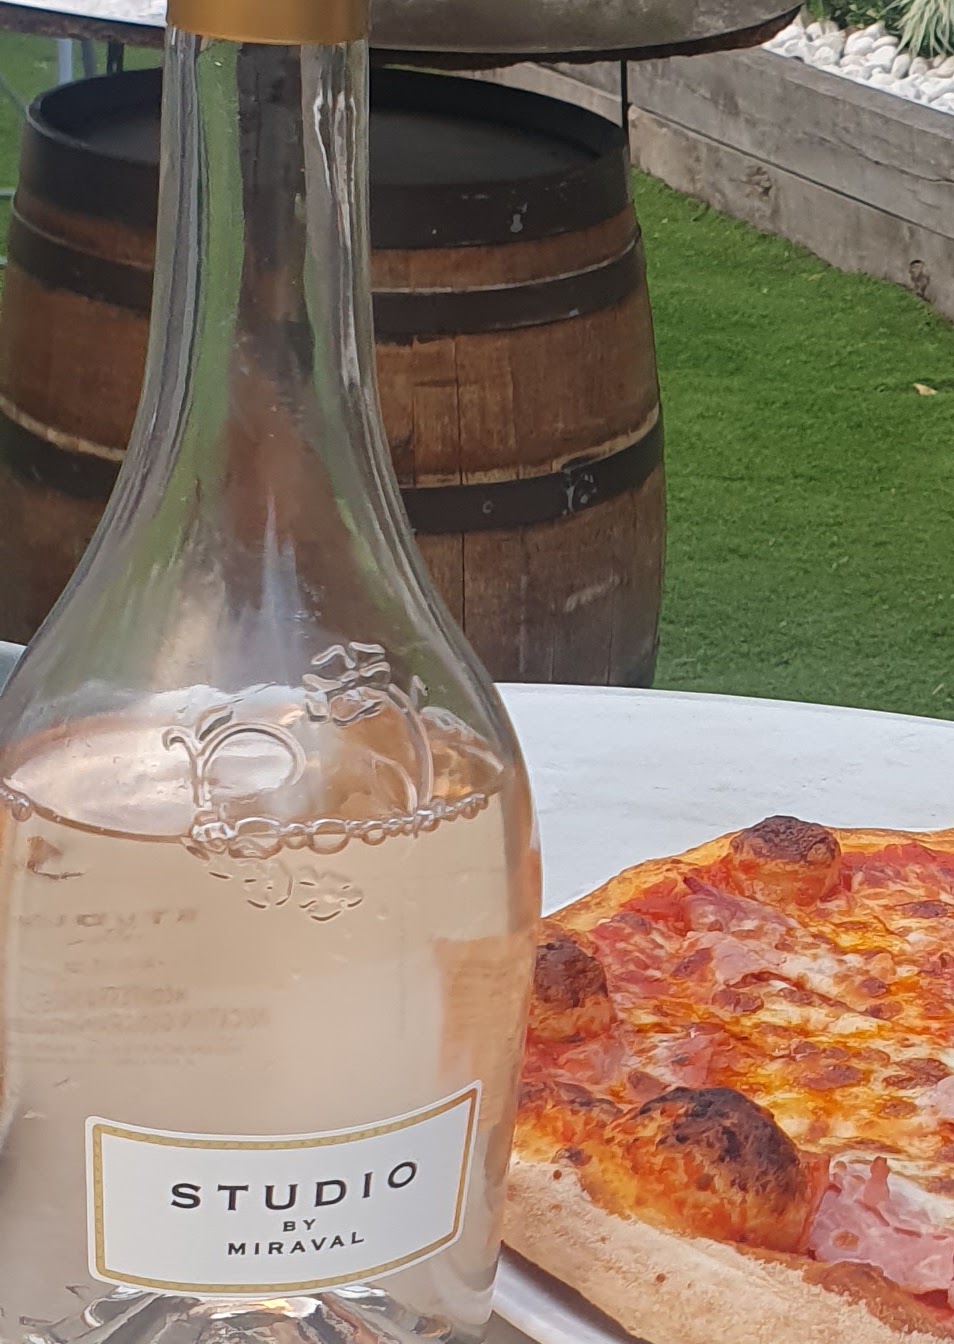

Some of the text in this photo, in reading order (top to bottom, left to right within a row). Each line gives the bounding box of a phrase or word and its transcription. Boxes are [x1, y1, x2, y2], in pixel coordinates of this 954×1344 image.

[170, 1160, 417, 1211] STUDIO
[283, 1219, 316, 1232] BY
[227, 1232, 365, 1256] MIRAVAL
